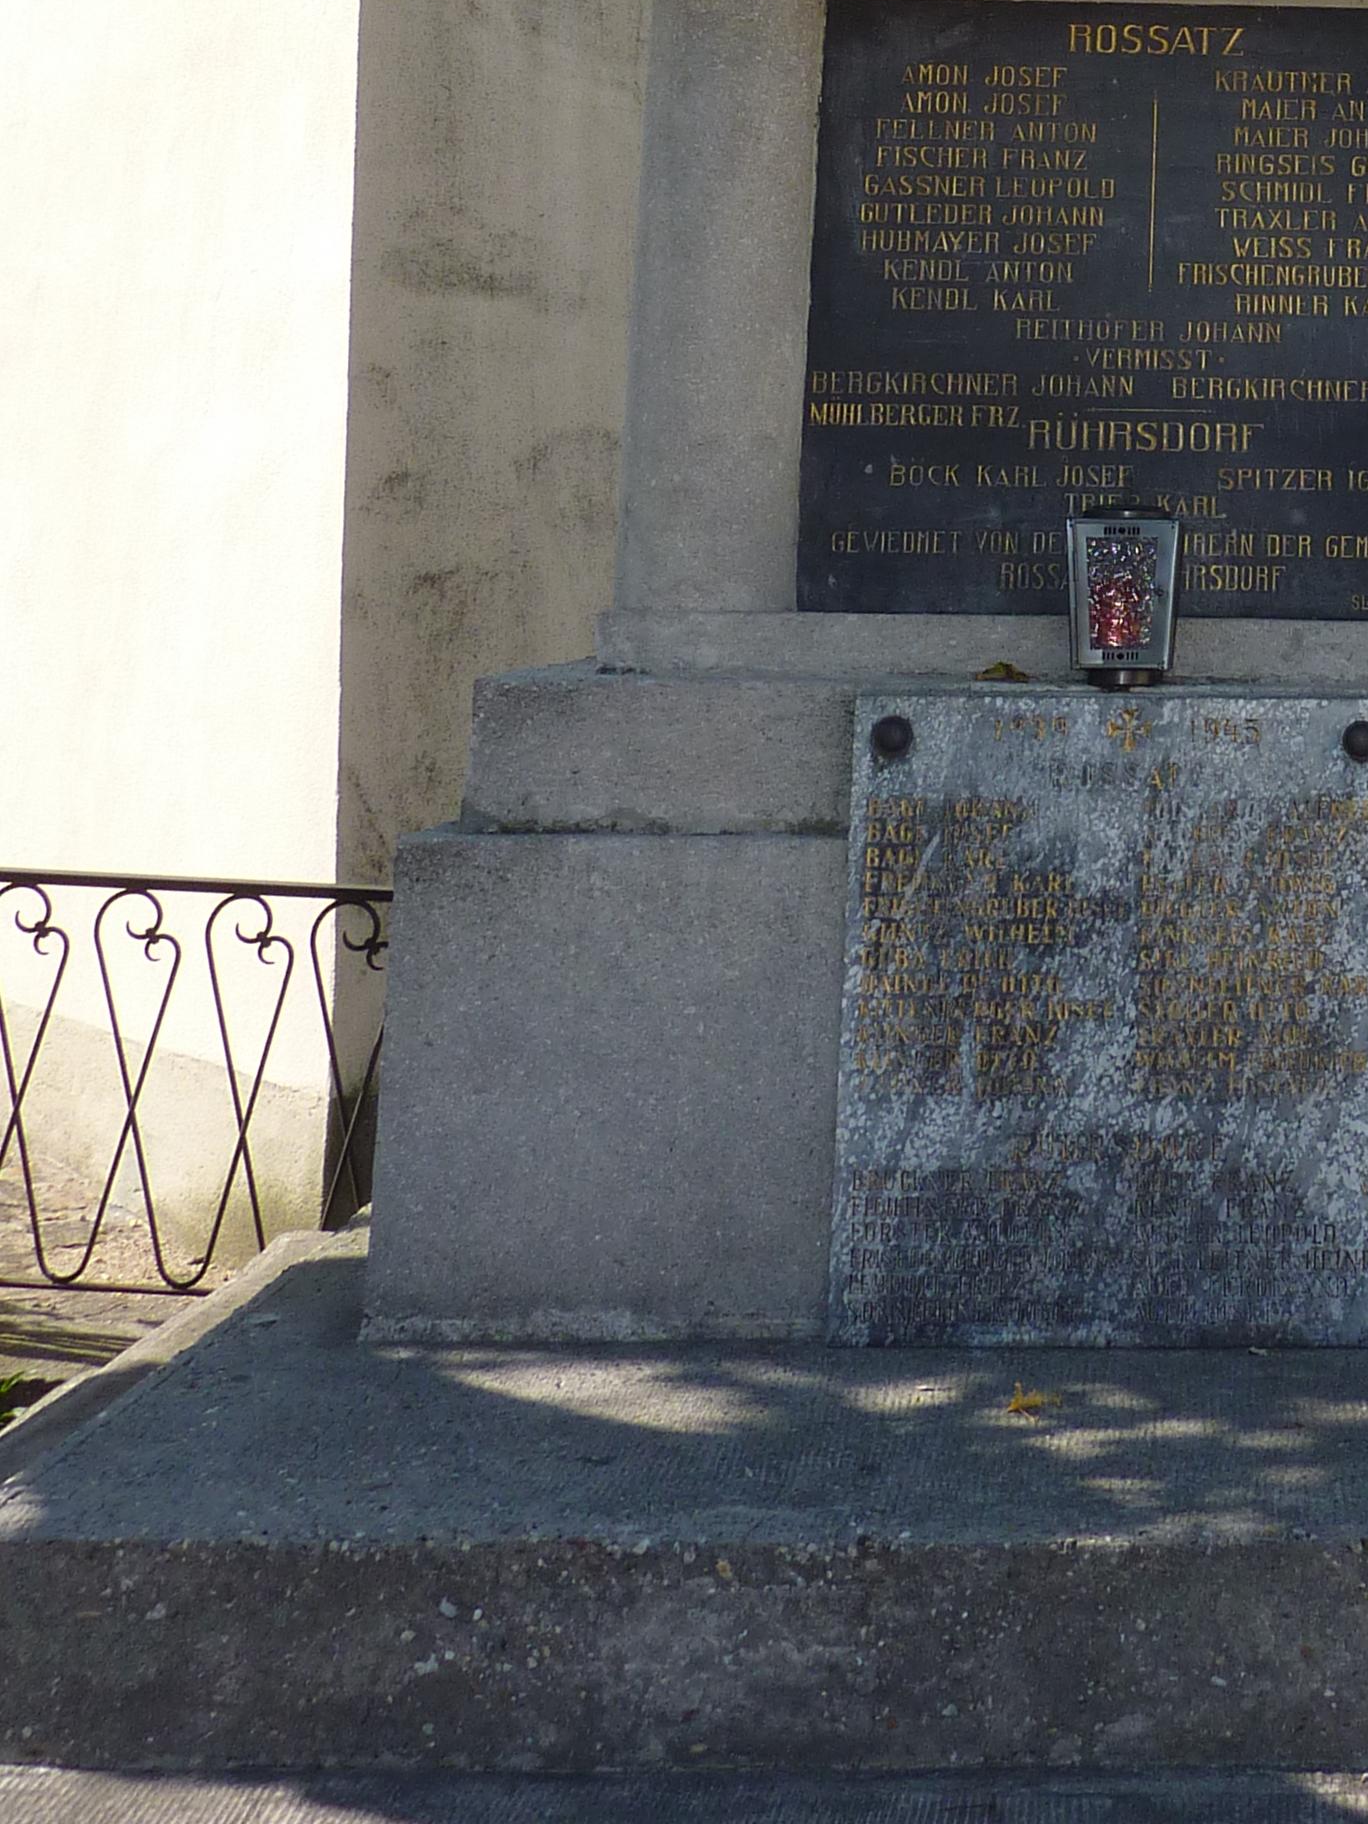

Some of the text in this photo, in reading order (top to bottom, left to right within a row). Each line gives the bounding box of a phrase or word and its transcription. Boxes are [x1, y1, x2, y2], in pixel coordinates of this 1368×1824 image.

[1068, 24, 1244, 56] ROSSATZ
[902, 64, 1068, 88] AMON JOSEF
[901, 91, 1068, 116] AMON JOSEF
[1241, 98, 1317, 121] MAIER
[875, 118, 1098, 144] FELLNER ANTON
[1233, 127, 1309, 148] MAIER
[876, 146, 1088, 171] FISCHER FRANZ
[1216, 154, 1335, 176] RINGSEIS
[864, 175, 1115, 199] GASSNER LEOPOLD
[1221, 181, 1333, 204] SCHMIDL
[860, 202, 1105, 227] GUTLEDER JOHANN
[860, 230, 1097, 256] HUBMAYER JOSEF
[1233, 236, 1312, 259] WEISS
[884, 259, 1073, 284] KENDL ANTON
[891, 287, 1061, 312] KENDL KARL
[1235, 293, 1328, 316] RINNER
[1015, 318, 1282, 344] REITHOFER JOHANN
[811, 371, 1135, 398] BERGKIRCHNER JOHANN
[809, 396, 965, 427] MÜHLBERGER
[1027, 412, 1265, 454] RÜHRSDORF
[976, 465, 1047, 488] KARL
[1056, 465, 1134, 489] JOSEF
[1217, 468, 1334, 491] SPITZER
[975, 532, 1018, 555] VON
[1266, 534, 1311, 558] DER
